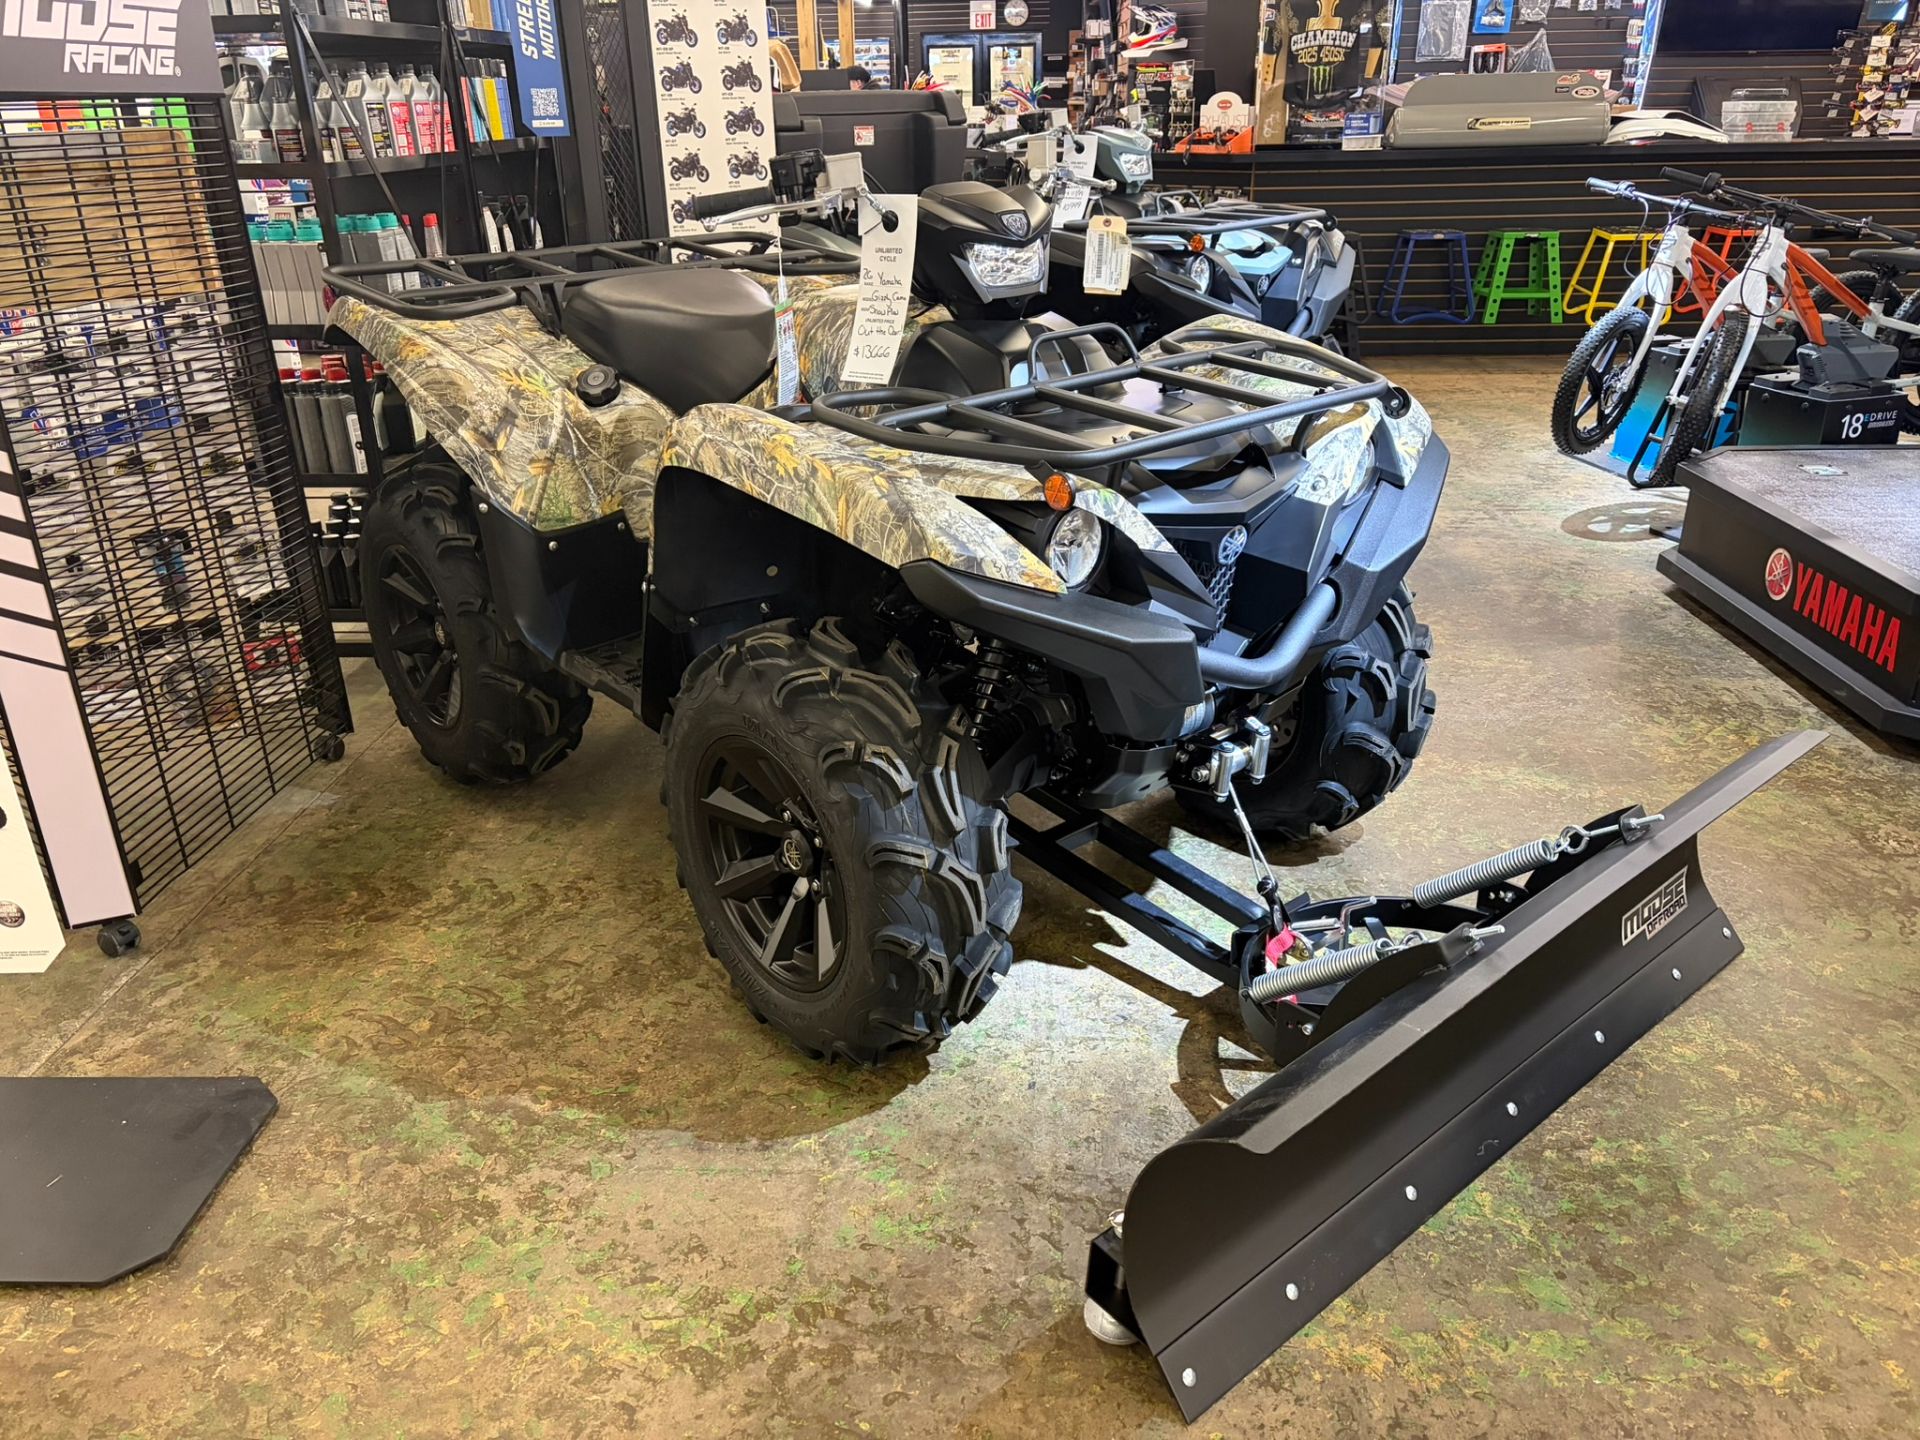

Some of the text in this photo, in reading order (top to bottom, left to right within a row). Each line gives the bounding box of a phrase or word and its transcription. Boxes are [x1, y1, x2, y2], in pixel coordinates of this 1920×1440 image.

[975, 13, 992, 28] EXIT
[1291, 29, 1357, 51] CHAMPION
[1298, 46, 1345, 63] 2025 450SX
[877, 271, 903, 287] Yamaha
[858, 324, 874, 336] Out
[876, 326, 887, 336] the
[1841, 413, 1864, 439] 18
[1793, 562, 1901, 673] YAMAHA
[1623, 869, 1686, 942] MOOSE
[1645, 894, 1687, 936] OFFROAD
